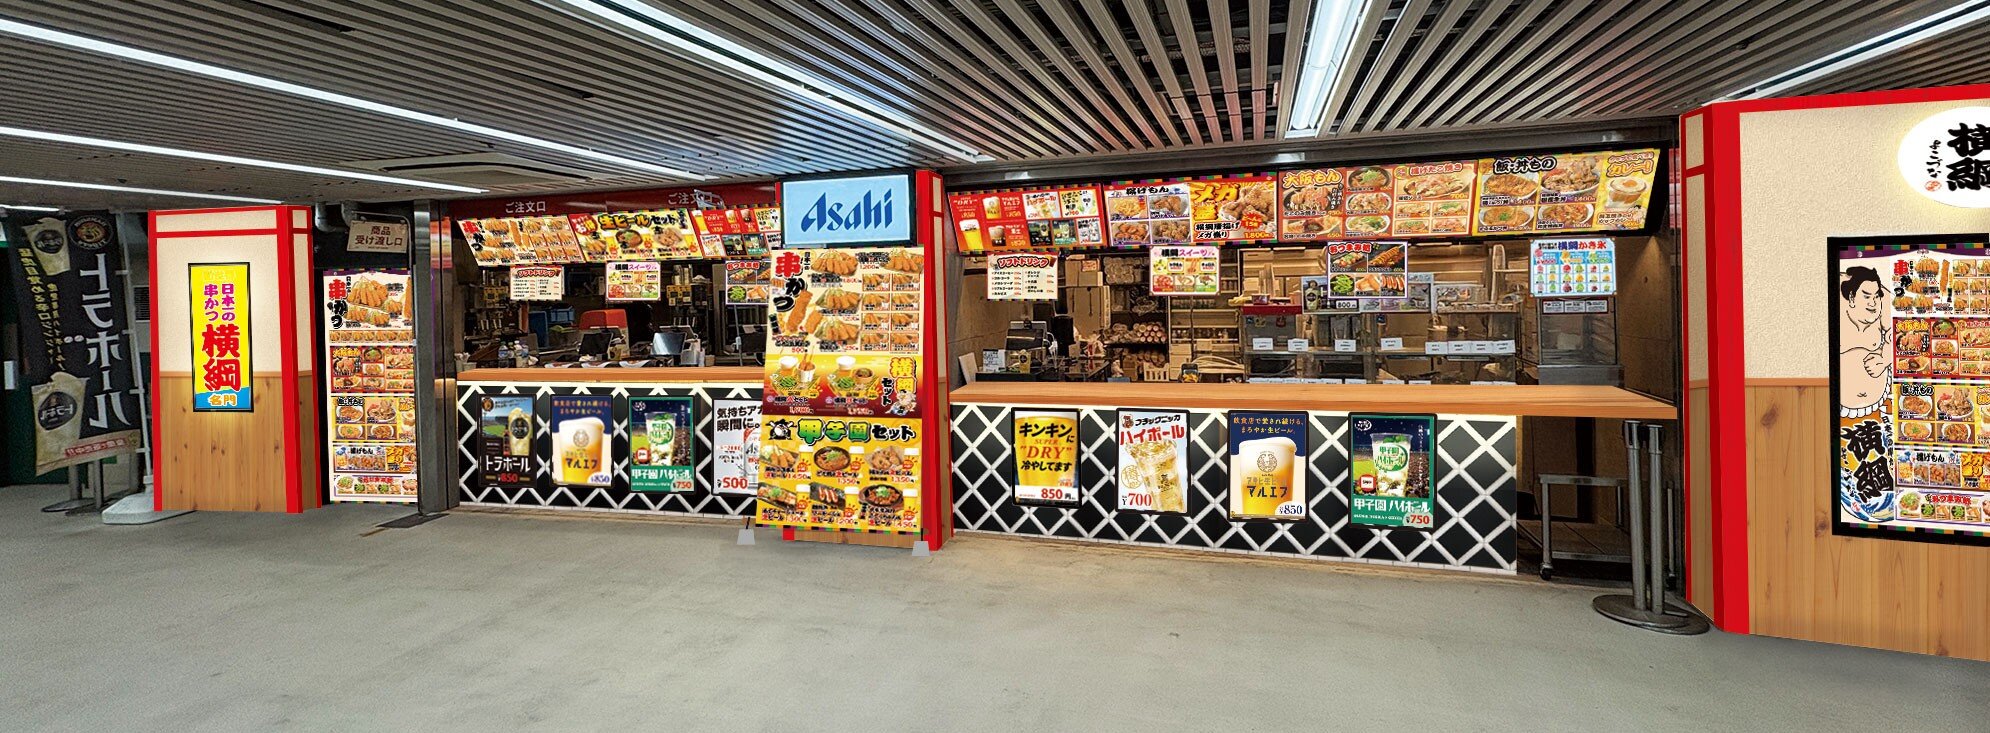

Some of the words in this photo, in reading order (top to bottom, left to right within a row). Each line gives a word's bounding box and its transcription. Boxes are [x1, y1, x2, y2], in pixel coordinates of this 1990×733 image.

[1495, 157, 1557, 173] 飯・丼もの
[1283, 169, 1342, 188] 大阪もん
[505, 201, 546, 213] ご注文口
[801, 188, 893, 232] Asahi
[371, 226, 391, 235] 商品
[355, 235, 403, 246] 受け渡し口
[998, 256, 1050, 268] ソフトドリンク
[773, 251, 807, 312] 串かつ
[204, 284, 219, 321] 串かつ
[221, 284, 235, 321] 日本一の
[201, 323, 241, 391] 横綱
[209, 394, 236, 406] 名門
[882, 378, 894, 406] セット
[716, 418, 761, 431] 瞬間に。
[1135, 414, 1181, 427] ブラックニッカ
[798, 419, 917, 446] 甲子園セット
[1019, 422, 1075, 443] キンキンに
[1120, 424, 1185, 445] ハイボール
[485, 456, 531, 472] トラボール
[565, 457, 598, 469] マルエフ
[1020, 460, 1072, 472] 冷やしてます
[1841, 420, 1894, 504] 横綱
[1247, 486, 1288, 498] マルエフ
[1354, 498, 1387, 512] 甲子園
[1388, 500, 1431, 513] ハイボール
